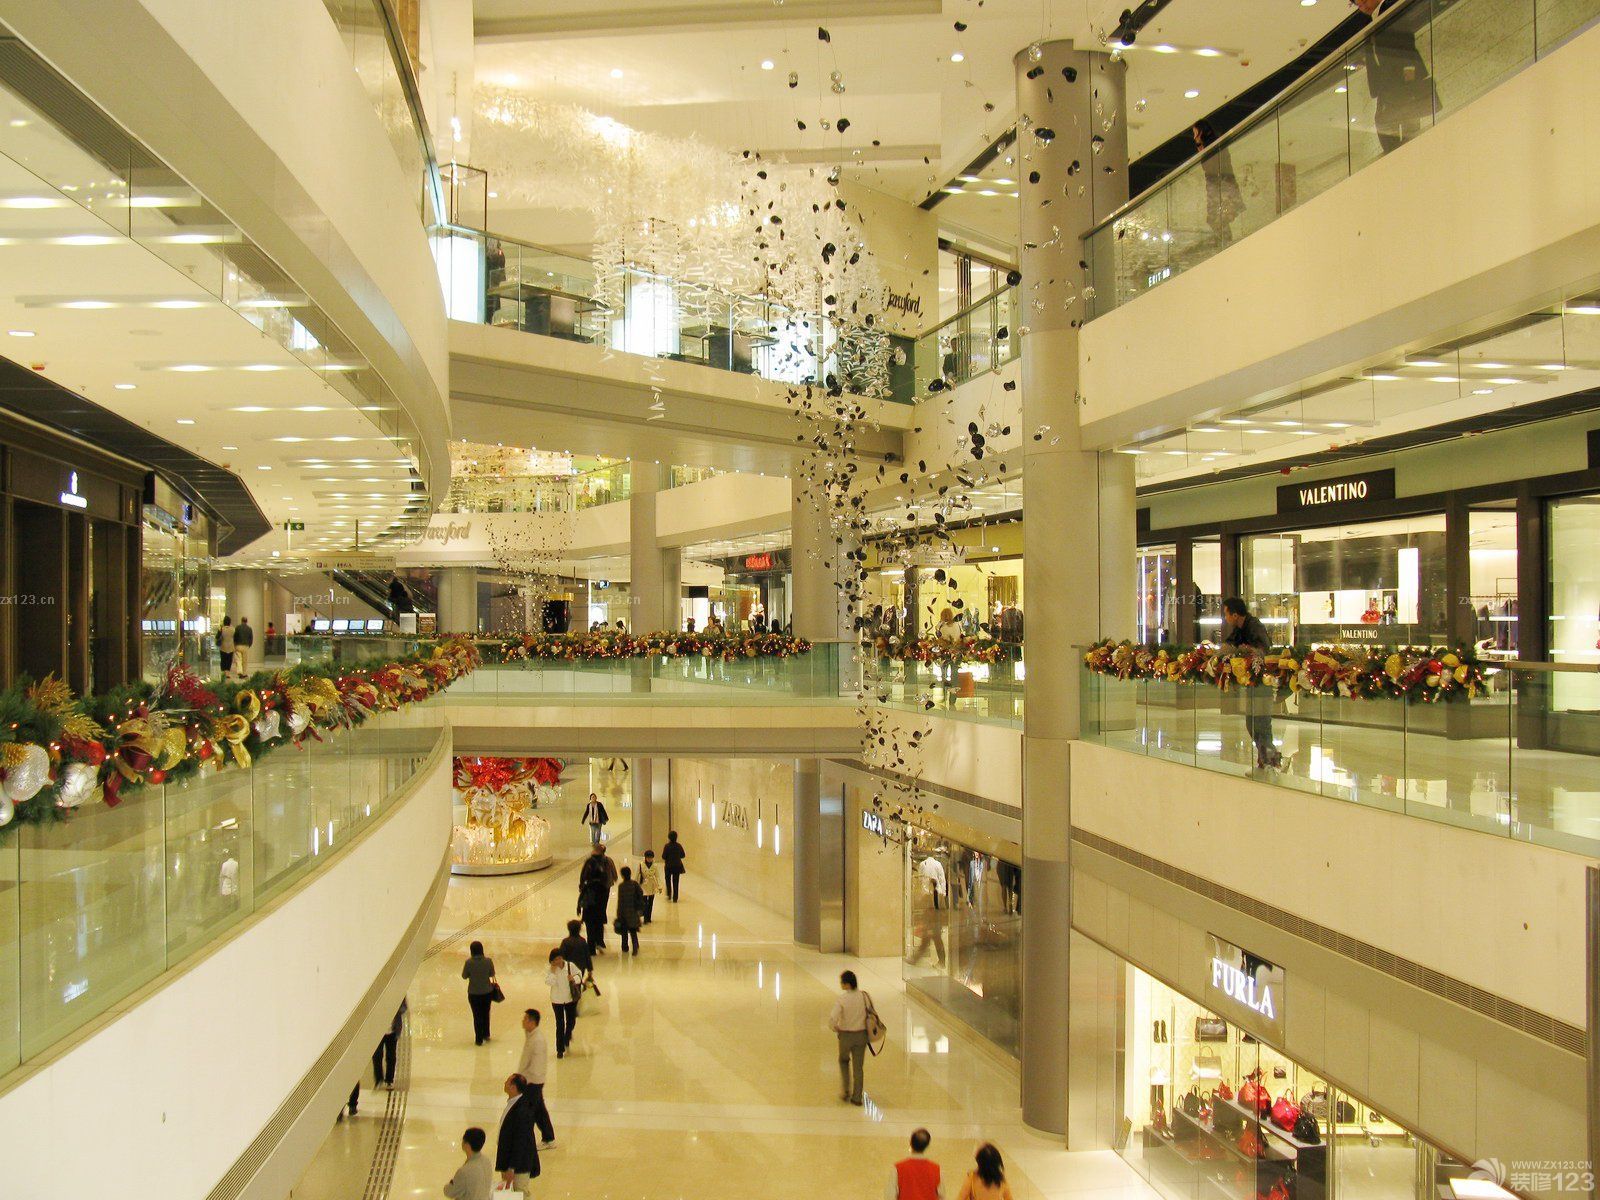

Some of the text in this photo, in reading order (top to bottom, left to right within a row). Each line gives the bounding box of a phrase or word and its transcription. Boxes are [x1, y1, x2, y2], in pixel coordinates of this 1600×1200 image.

[1299, 480, 1368, 506] VALENTINO
[1342, 629, 1378, 639] VALENTINO
[721, 799, 749, 831] ZARA
[863, 810, 883, 836] ZARA
[1211, 957, 1275, 1020] FURLA
